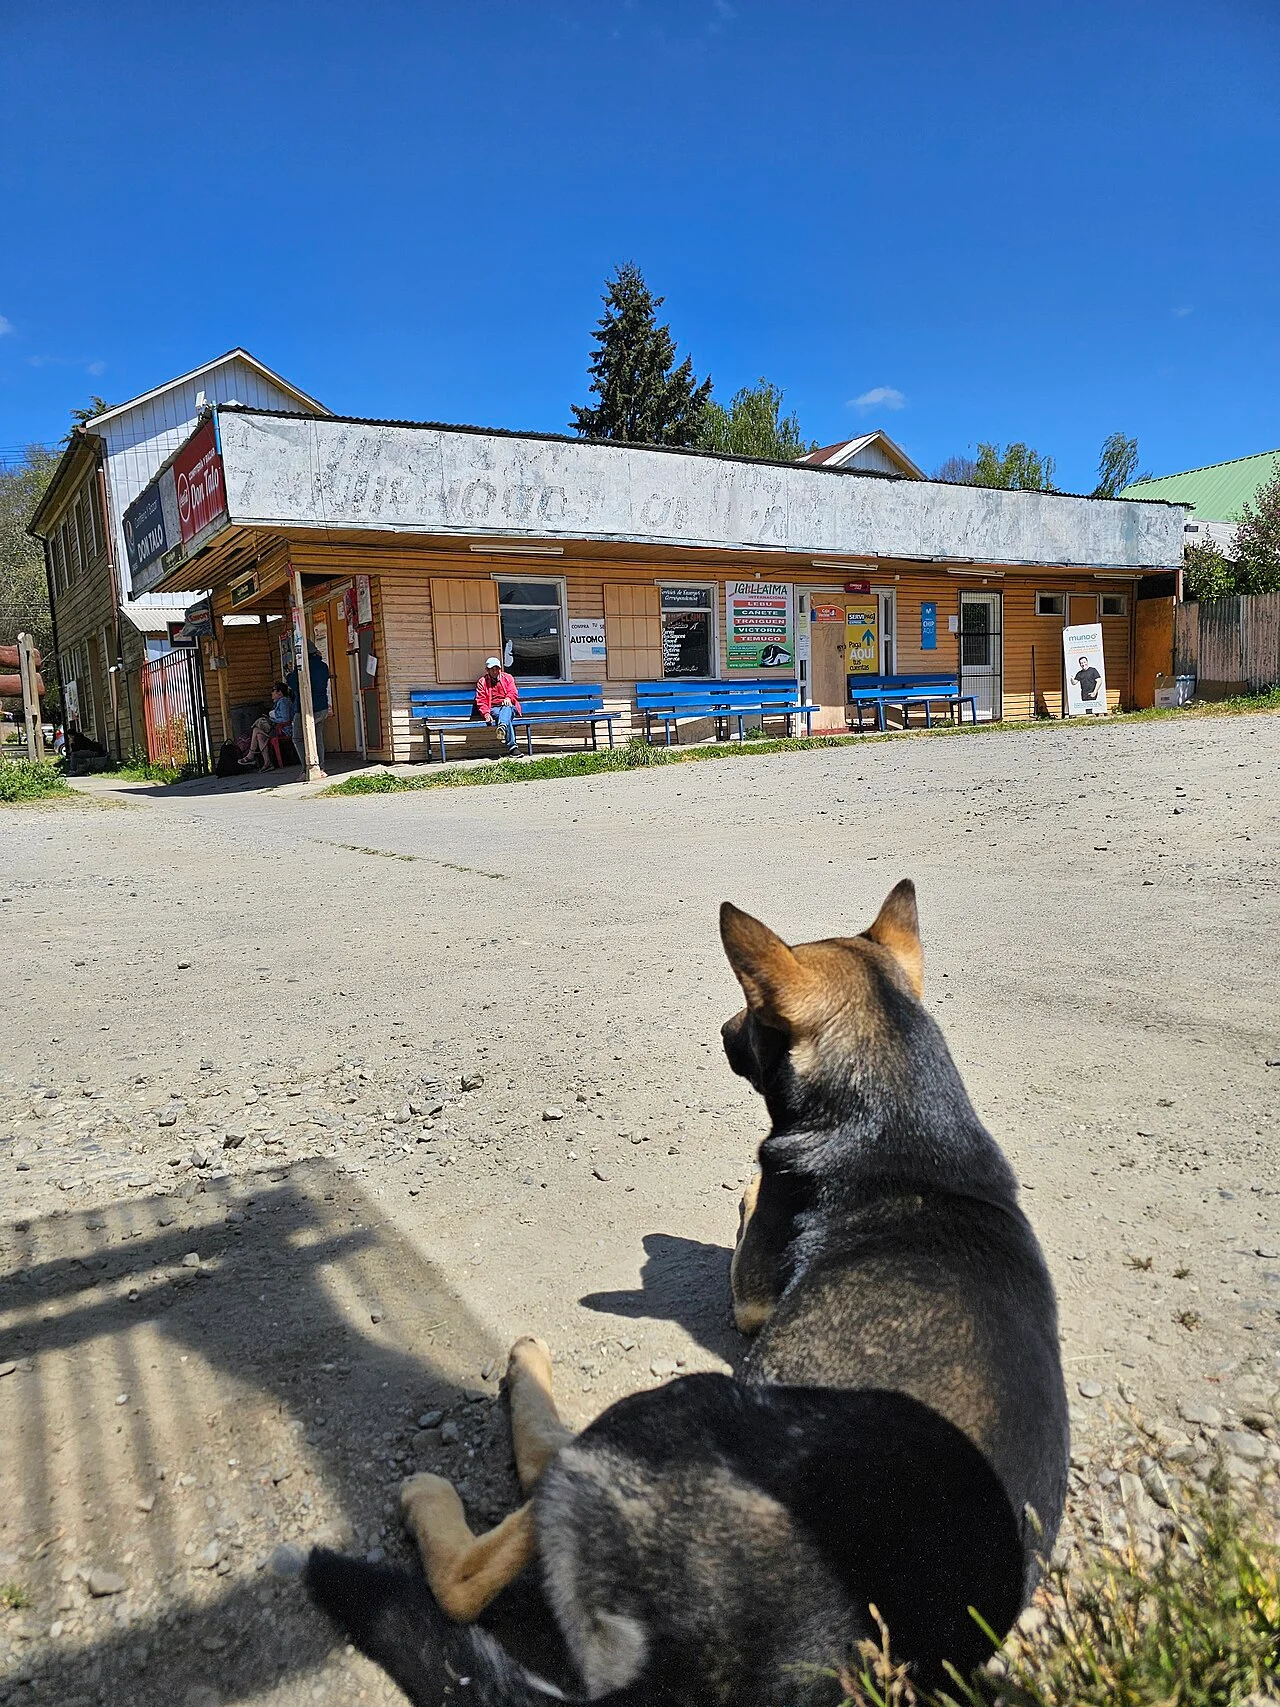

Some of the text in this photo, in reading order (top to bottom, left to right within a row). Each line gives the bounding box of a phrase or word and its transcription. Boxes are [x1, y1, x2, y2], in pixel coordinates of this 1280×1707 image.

[190, 465, 219, 509] Don Talo
[137, 536, 151, 562] DON
[148, 524, 164, 553] TALO
[848, 641, 862, 649] Paga
[850, 645, 875, 660] AQUÍ
